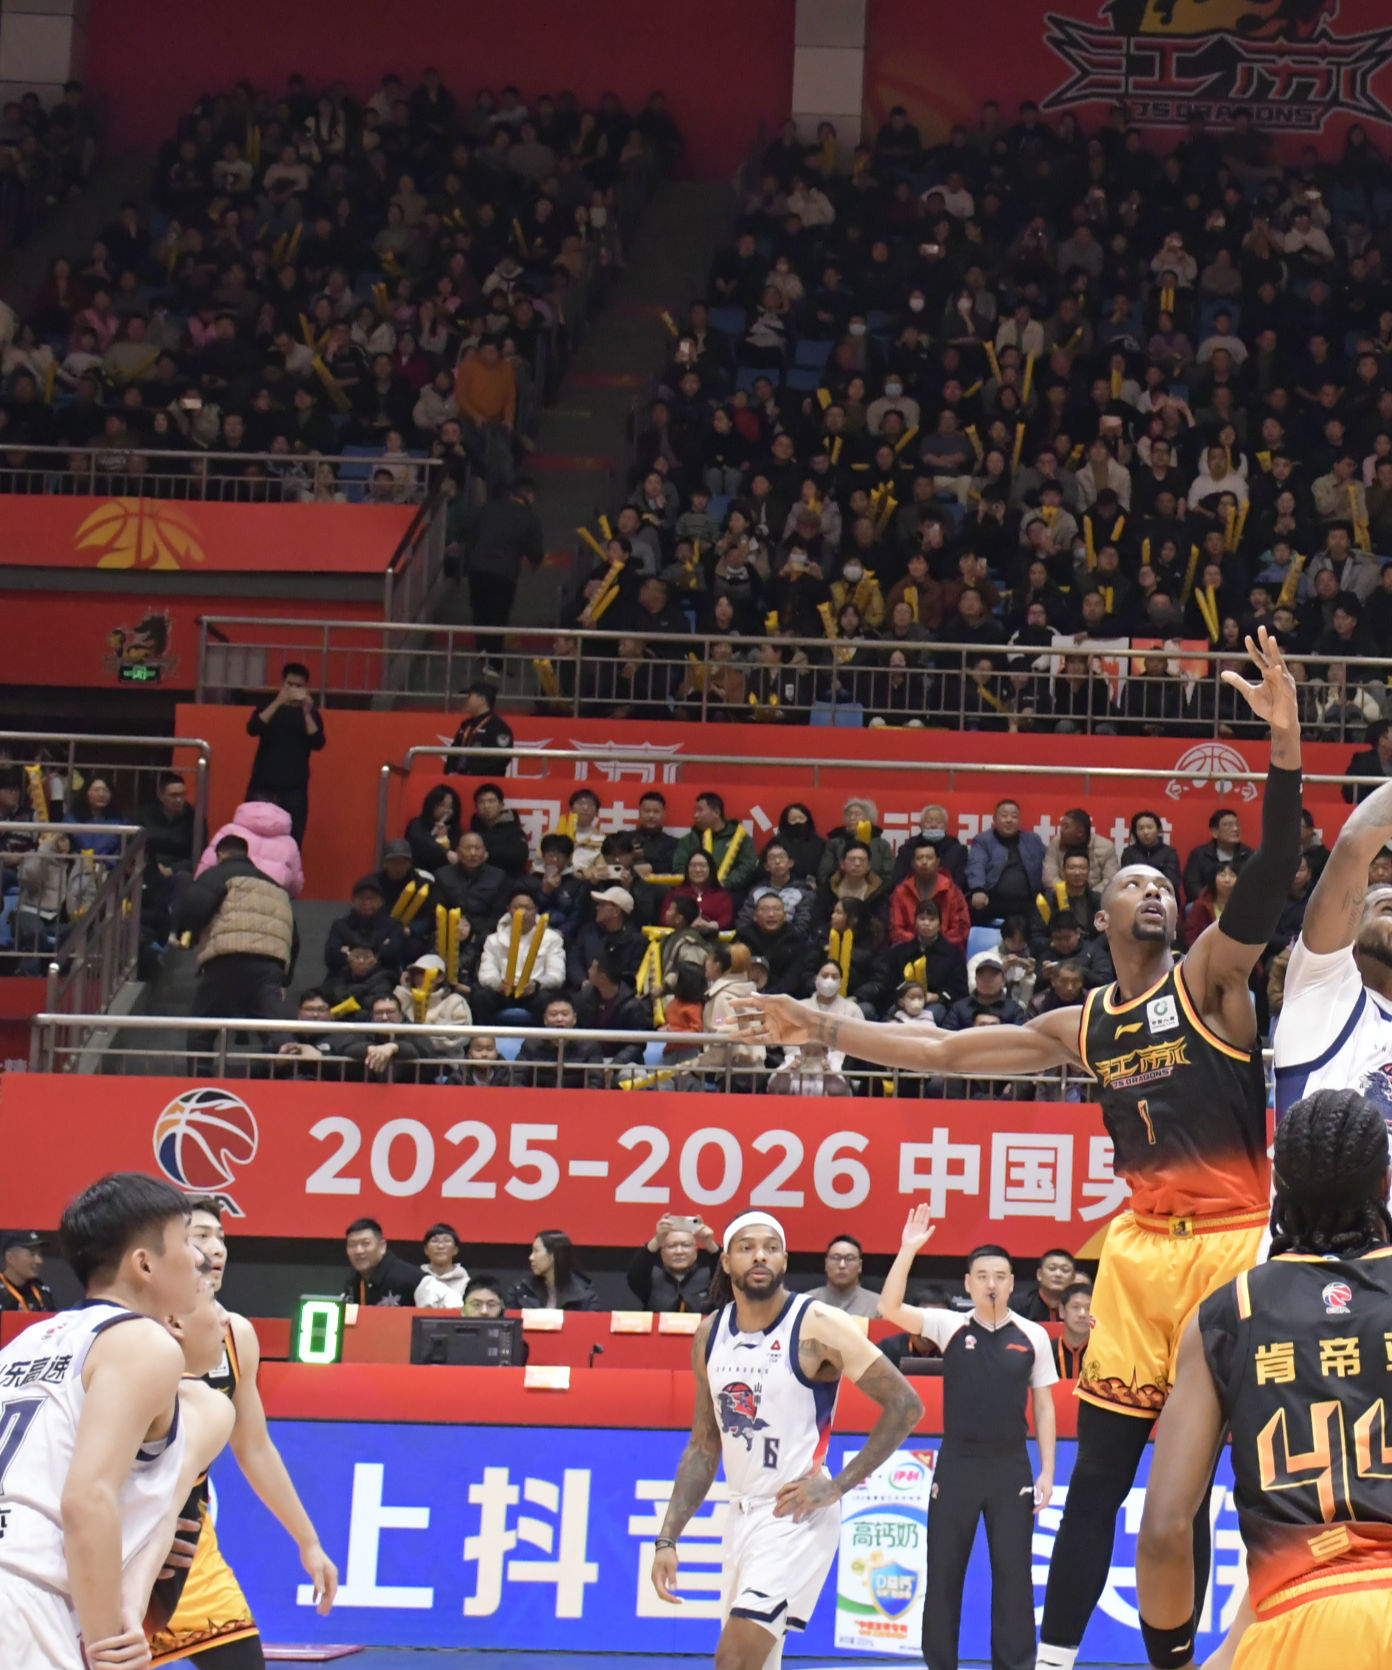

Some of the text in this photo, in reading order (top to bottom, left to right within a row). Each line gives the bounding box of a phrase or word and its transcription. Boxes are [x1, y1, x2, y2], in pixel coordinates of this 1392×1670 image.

[1137, 1099, 1156, 1145] 1
[306, 1117, 870, 1209] 2025-2026
[298, 1301, 341, 1364] 0
[0, 1354, 72, 1388] 东高速
[763, 1437, 780, 1470] 6
[853, 1522, 919, 1548] 高钙奶
